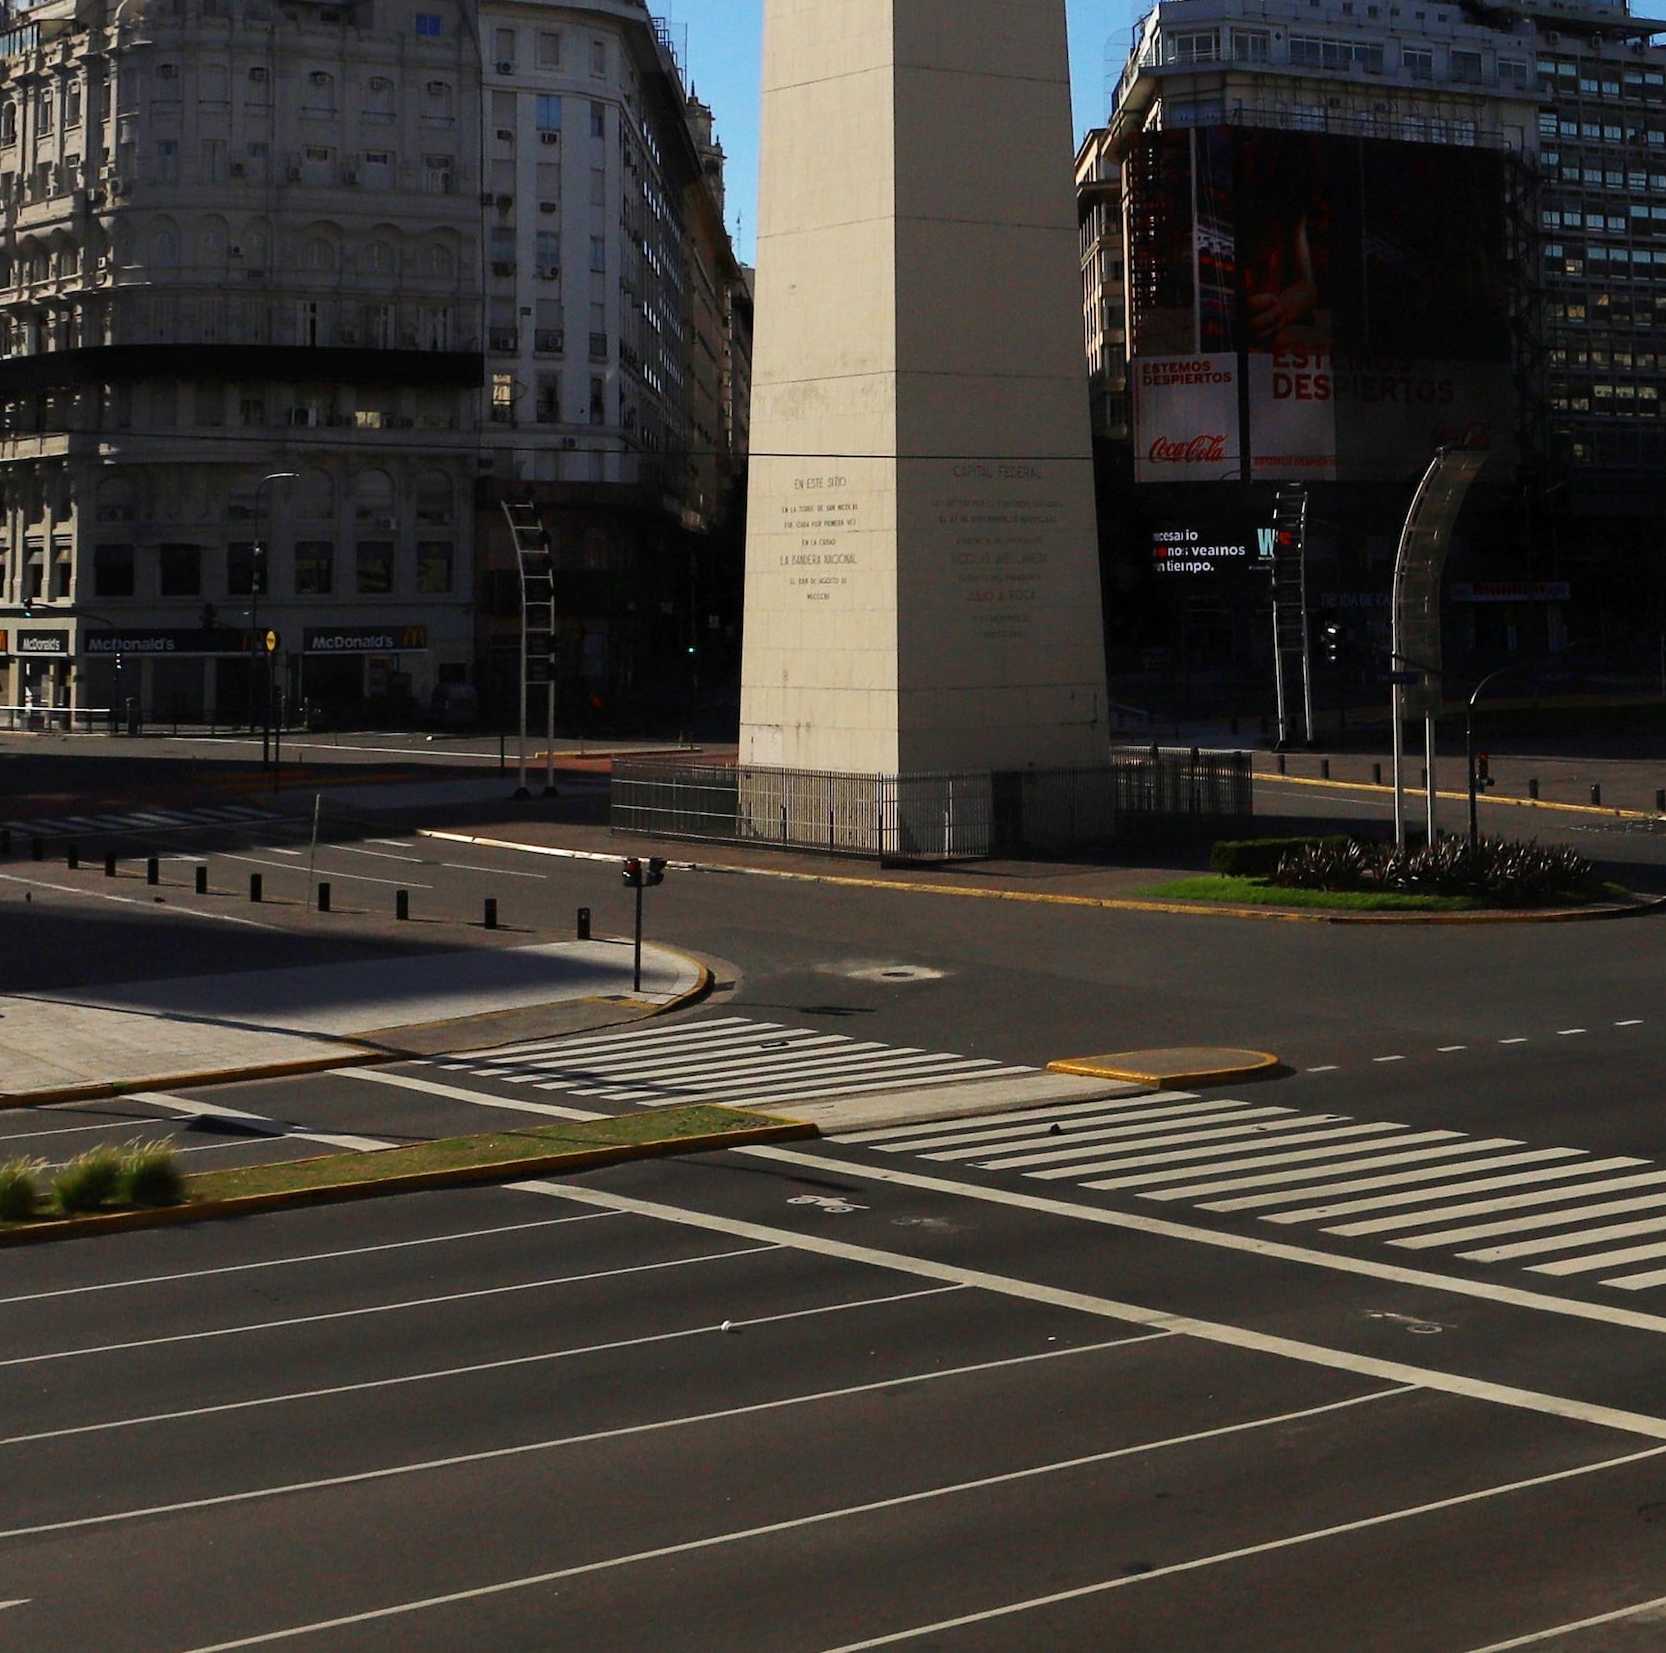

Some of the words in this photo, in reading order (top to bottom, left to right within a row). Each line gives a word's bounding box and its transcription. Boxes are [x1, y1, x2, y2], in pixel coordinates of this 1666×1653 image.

[1142, 360, 1211, 374] ESTEMOS
[1142, 372, 1232, 386] DESPIERTOS
[1273, 373, 1454, 405] DESPIERTOS
[952, 465, 993, 479] CAPITAL
[997, 465, 1042, 479] FEDERAL
[794, 478, 804, 490] EN
[806, 477, 823, 489] ESTE
[827, 476, 847, 488] SITIO
[780, 555, 789, 566] LA
[792, 554, 821, 565] BANDERA
[823, 553, 858, 565] NACIONAL
[22, 636, 61, 651] McDonald's
[88, 635, 177, 652] McDonald's
[312, 634, 394, 650] McDonald's
